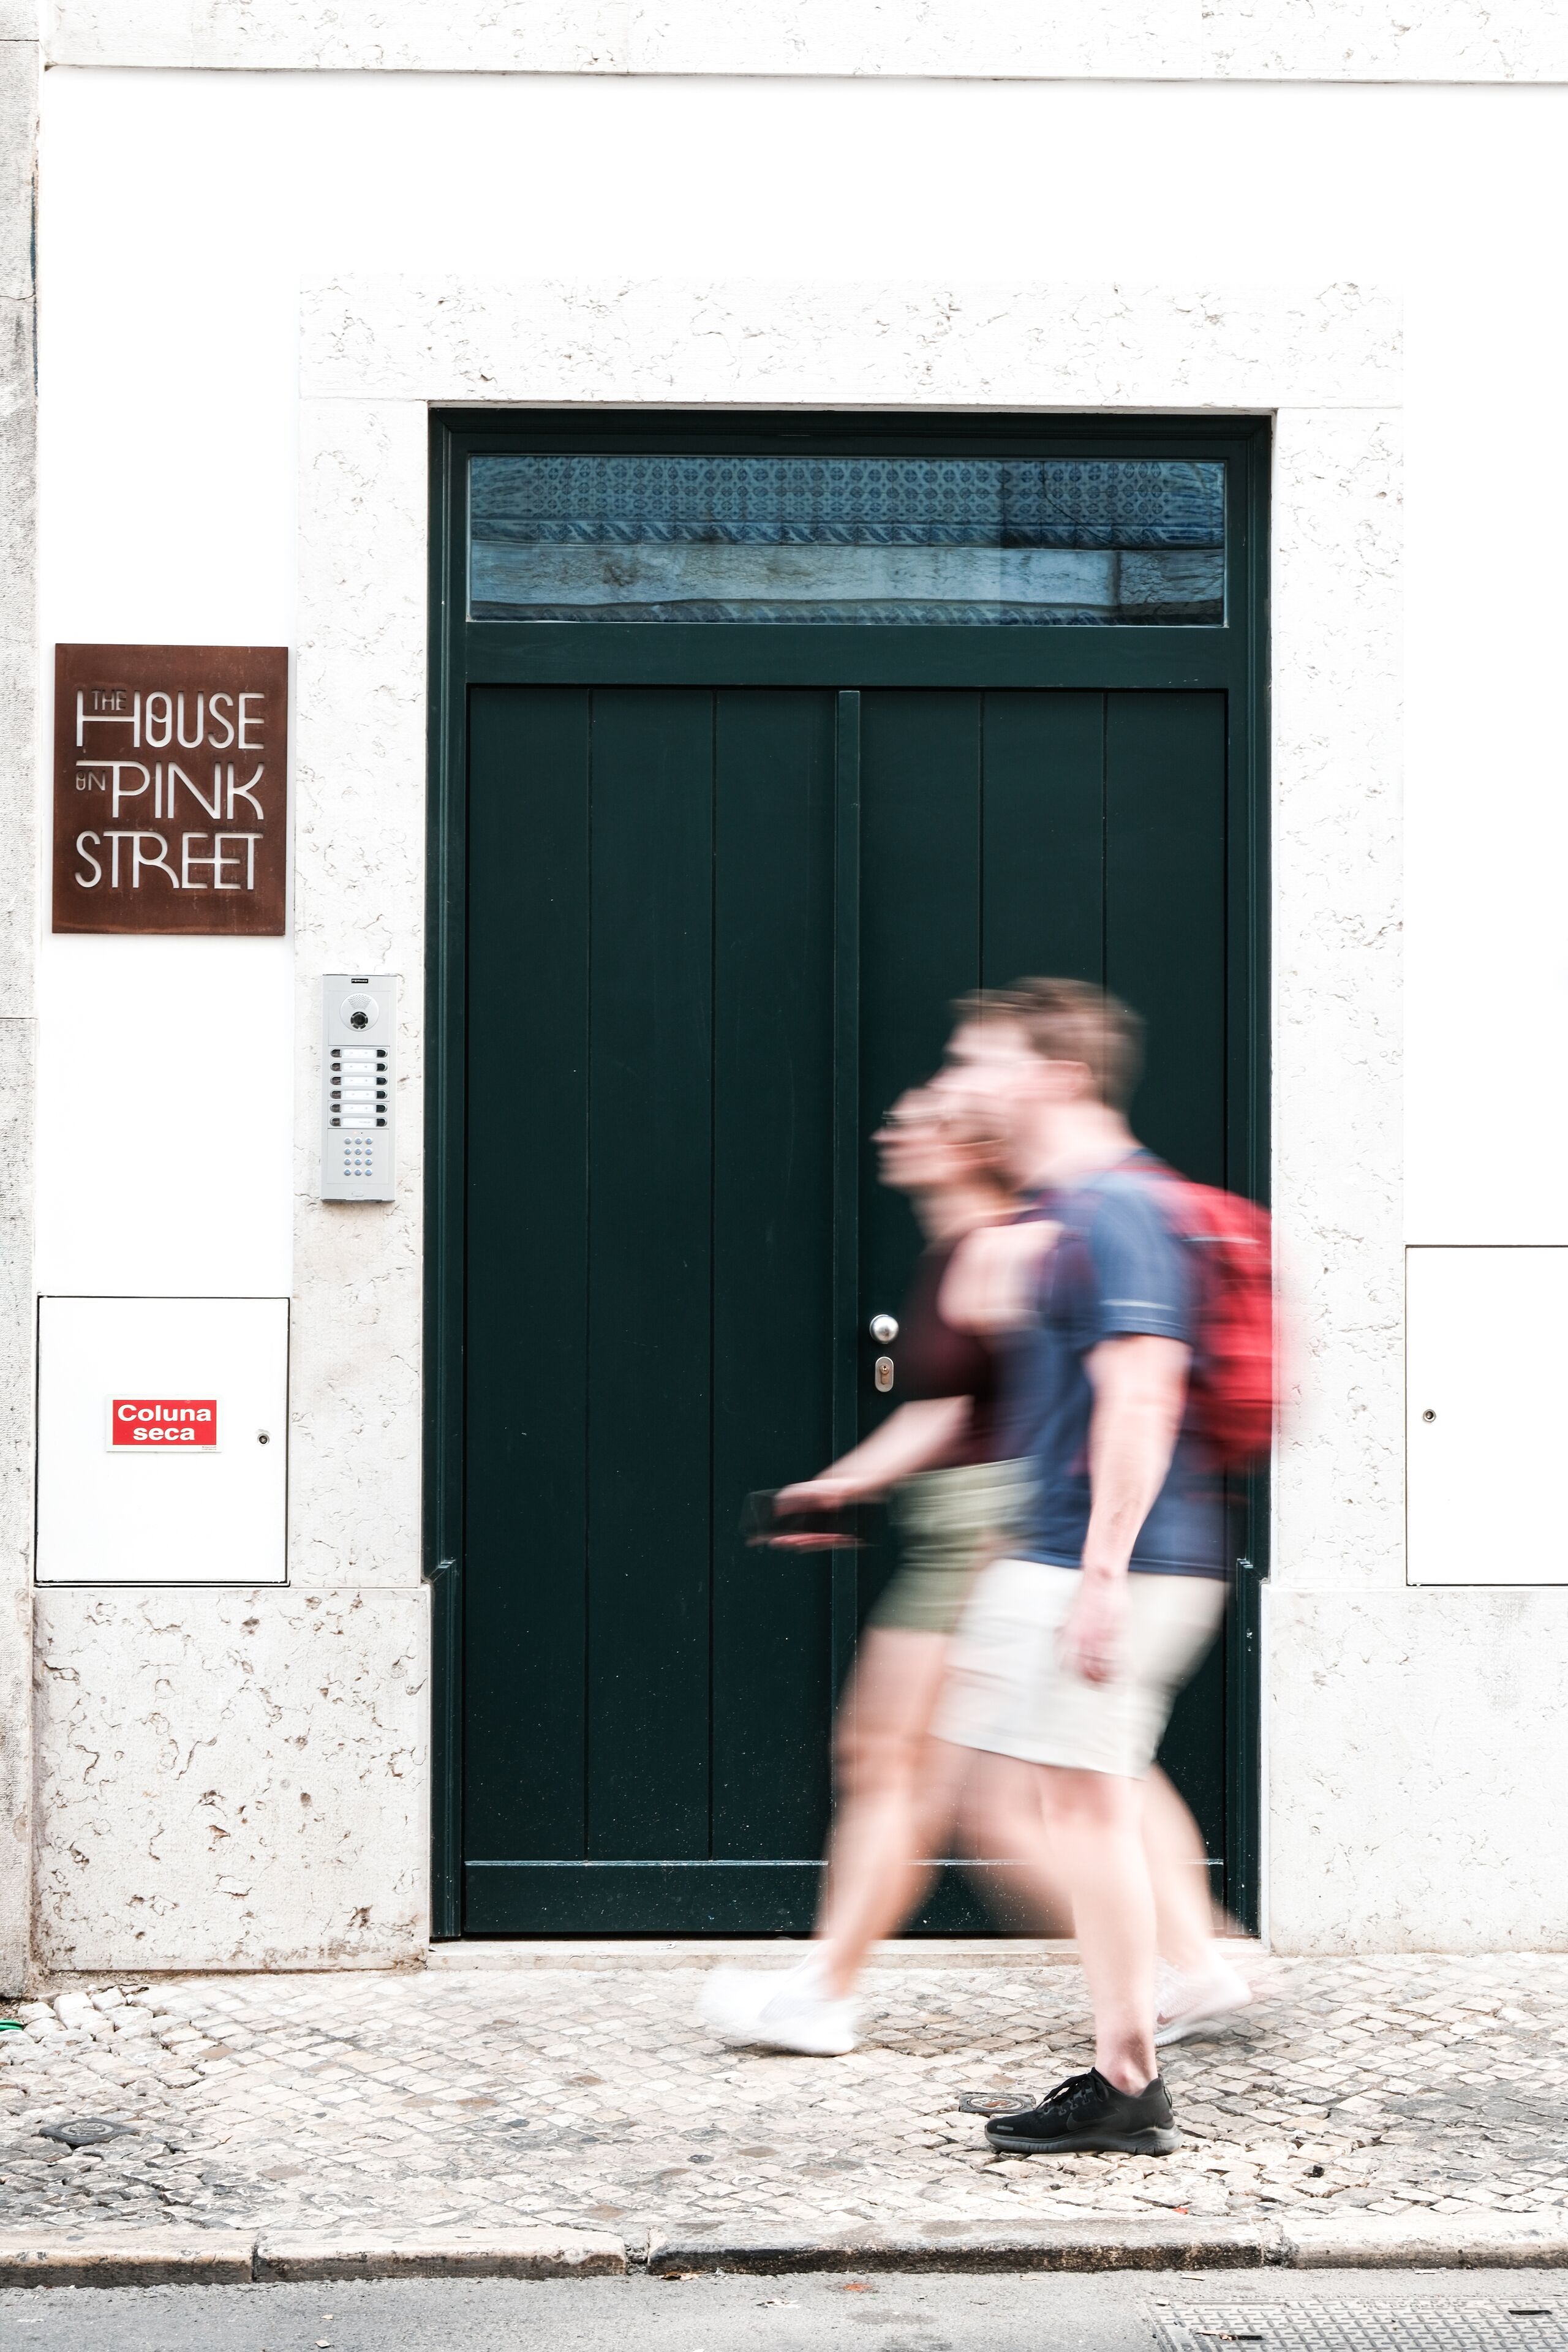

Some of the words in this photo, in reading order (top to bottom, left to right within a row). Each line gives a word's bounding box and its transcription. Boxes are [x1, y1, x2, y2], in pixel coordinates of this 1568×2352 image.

[92, 690, 126, 710] THE
[76, 690, 265, 749] HOUSE
[76, 771, 106, 791] ON
[76, 760, 265, 820] PINK
[75, 831, 263, 890] STREET
[118, 1404, 211, 1422] Coluna
[133, 1428, 195, 1441] seca
